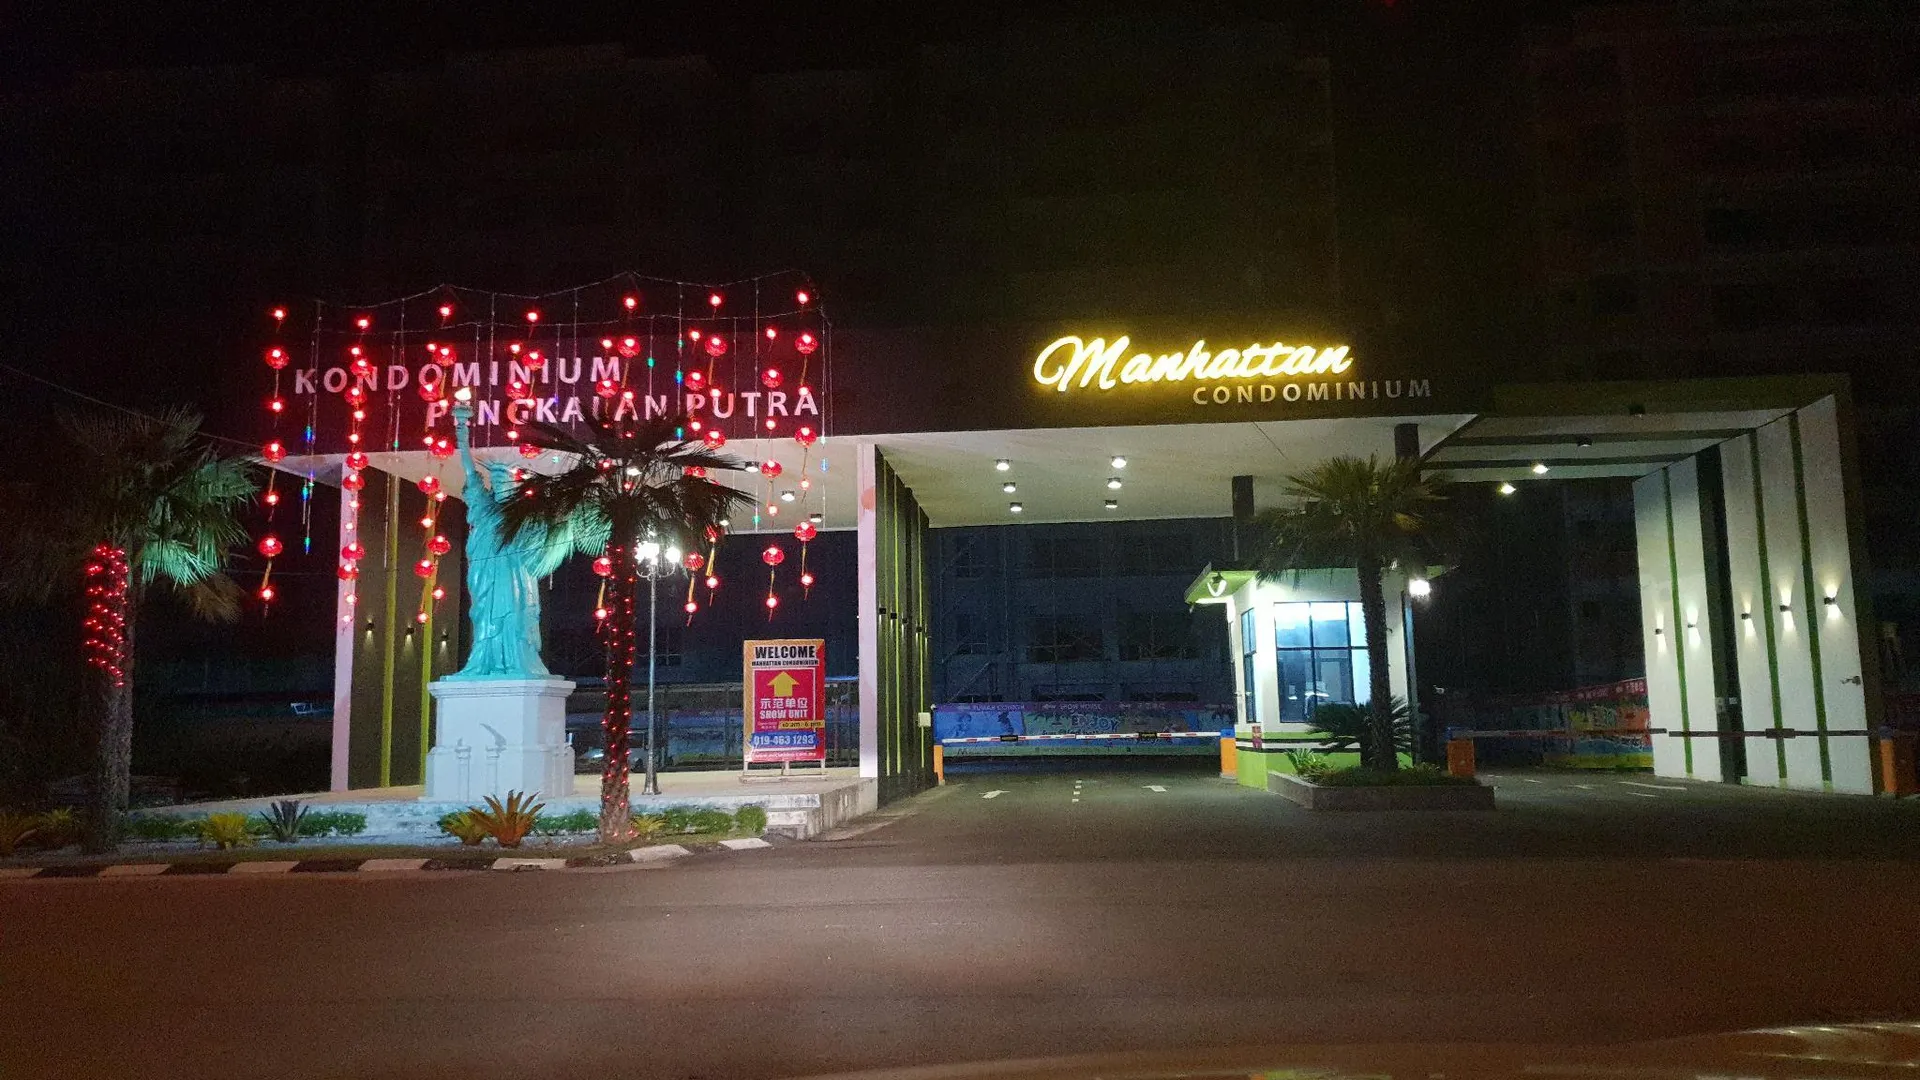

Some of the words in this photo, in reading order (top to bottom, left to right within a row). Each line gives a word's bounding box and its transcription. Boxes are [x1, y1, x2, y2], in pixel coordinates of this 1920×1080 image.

[295, 355, 621, 394] KONDOMINIUM
[1033, 335, 1353, 392] Manhattan
[1192, 379, 1431, 405] CONDOMINIUM
[426, 394, 667, 428] PNGKALAN
[686, 391, 819, 419] PUTRA
[755, 645, 815, 659] WELCOME
[759, 709, 786, 720] SHOW
[788, 709, 808, 719] UNIT
[760, 698, 808, 709] 示范单位
